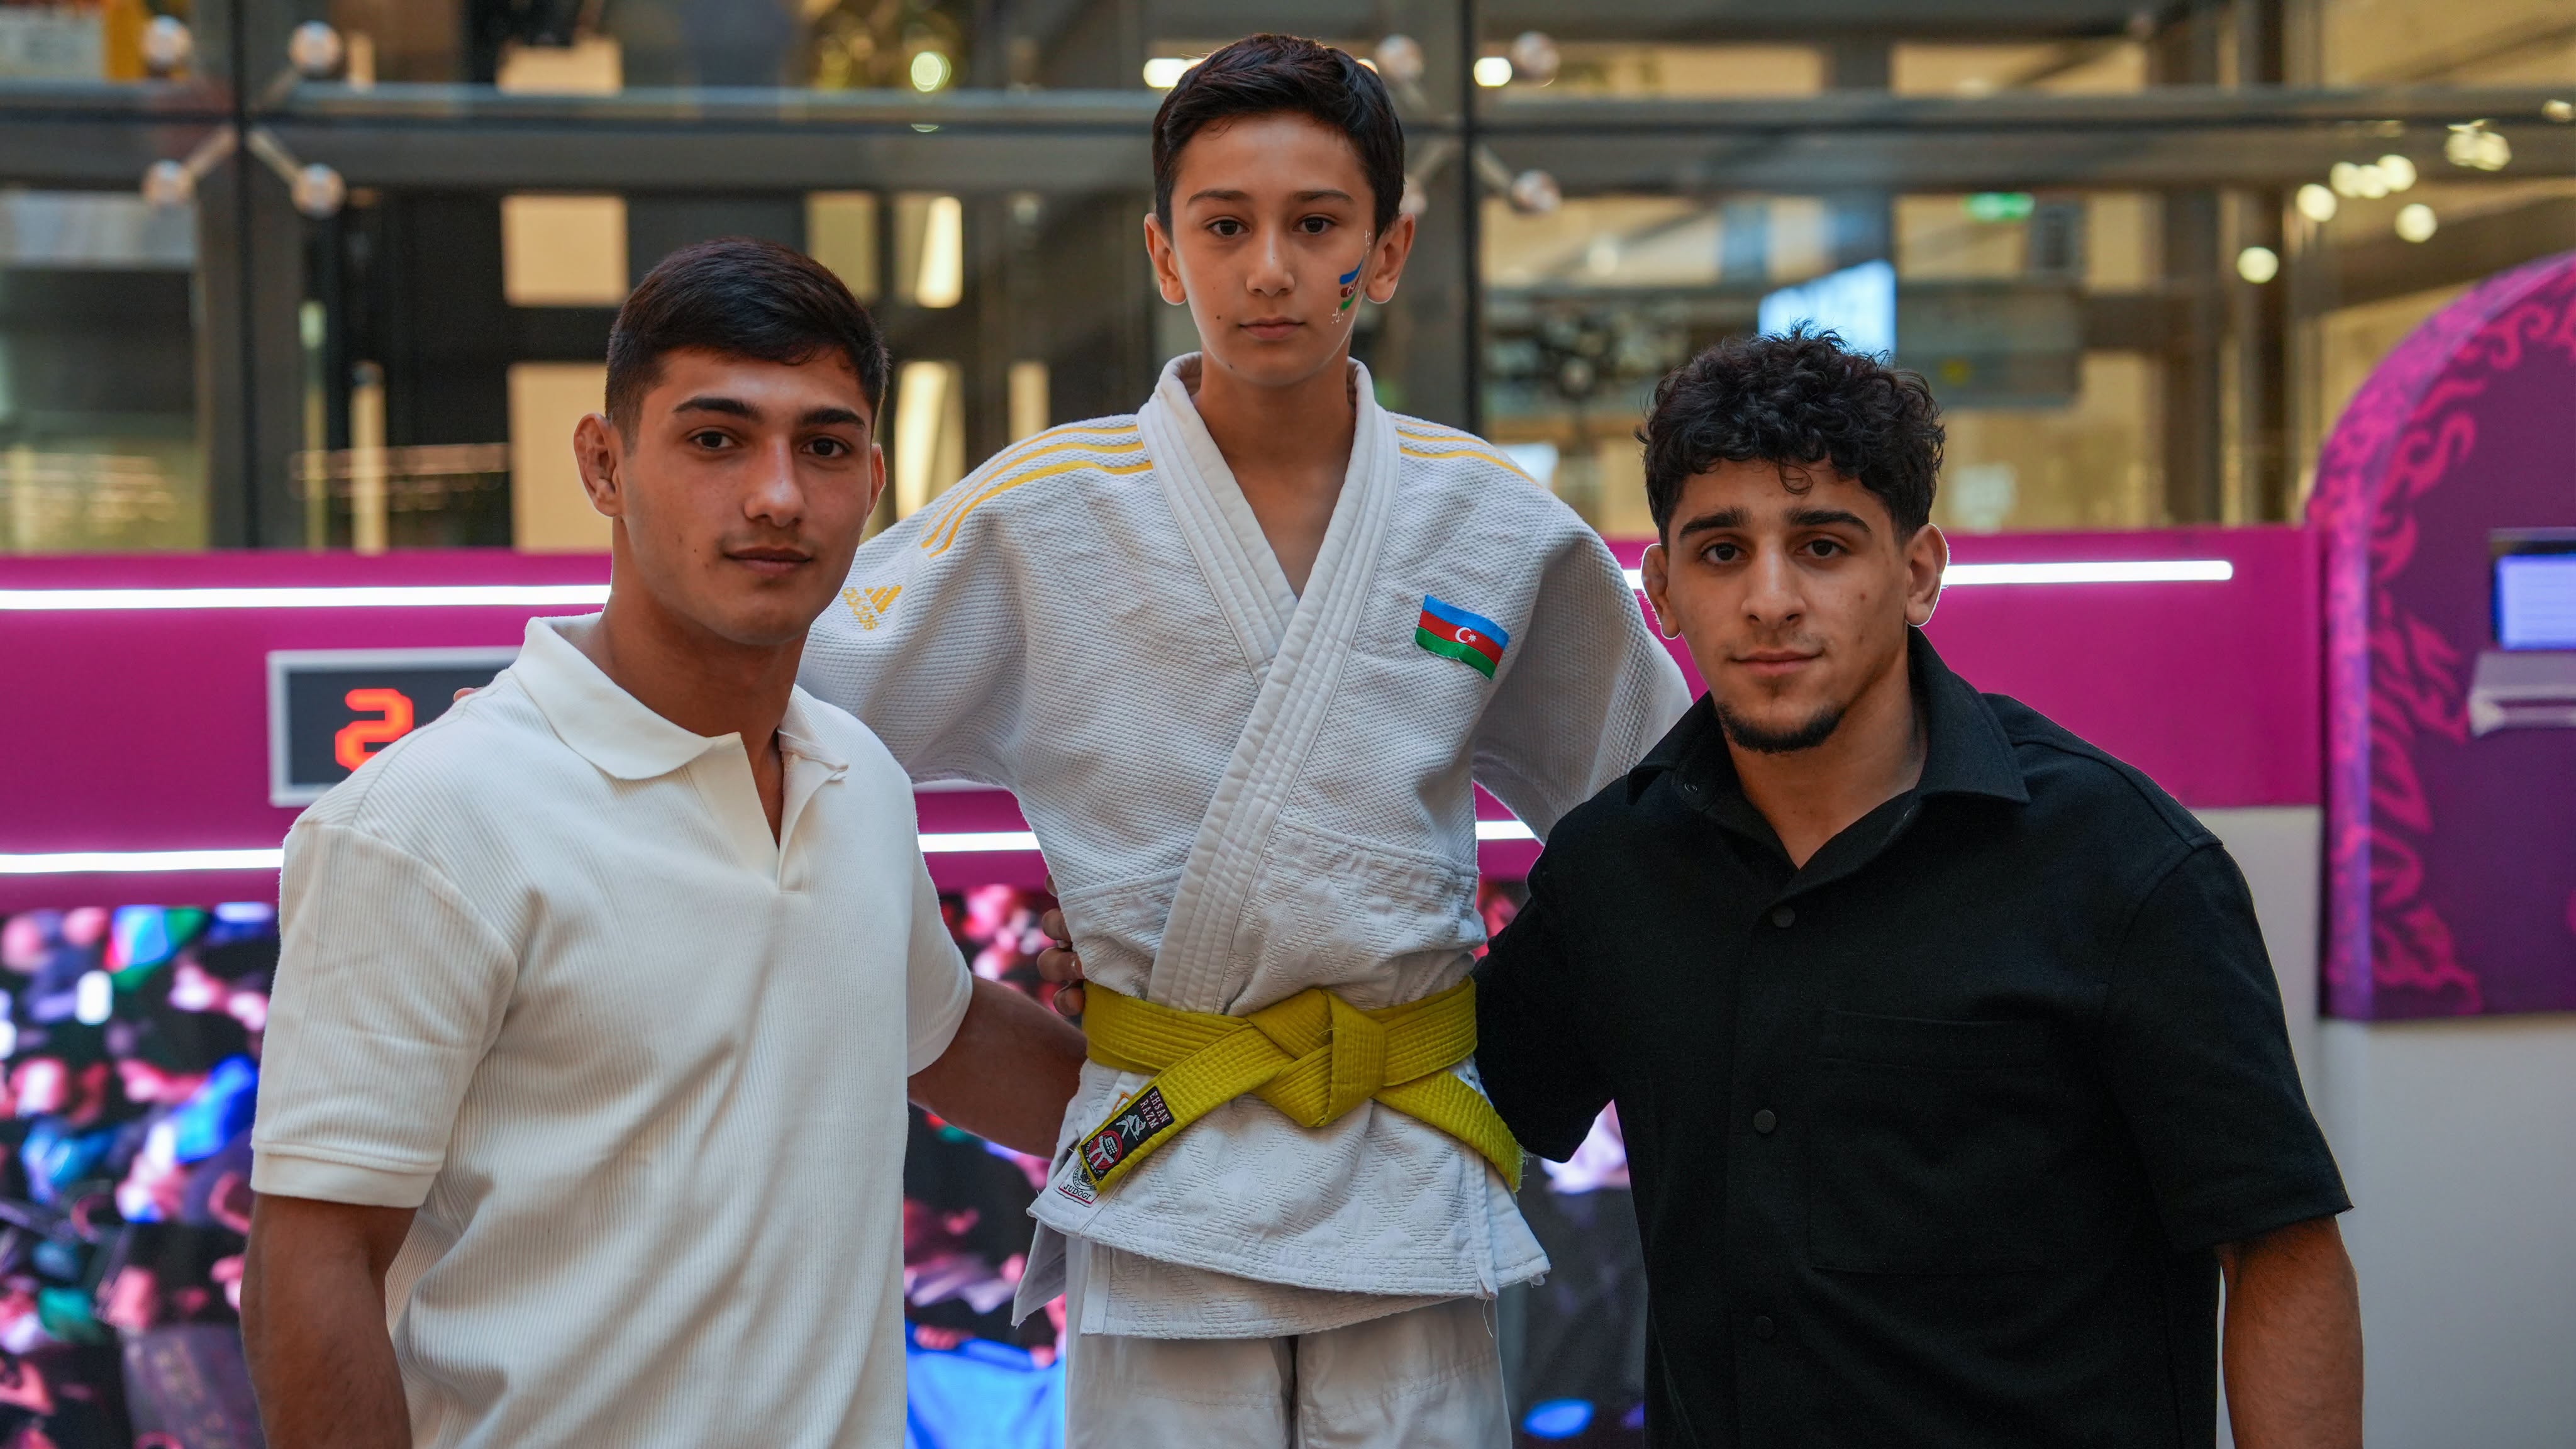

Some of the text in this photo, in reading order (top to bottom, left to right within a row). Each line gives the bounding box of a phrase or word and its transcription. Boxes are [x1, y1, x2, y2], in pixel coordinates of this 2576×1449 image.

[335, 688, 413, 772] 2
[1140, 1098, 1159, 1129] RAZM
[1150, 1091, 1170, 1123] EHSAN
[1063, 1184, 1091, 1200] JUDOGI
